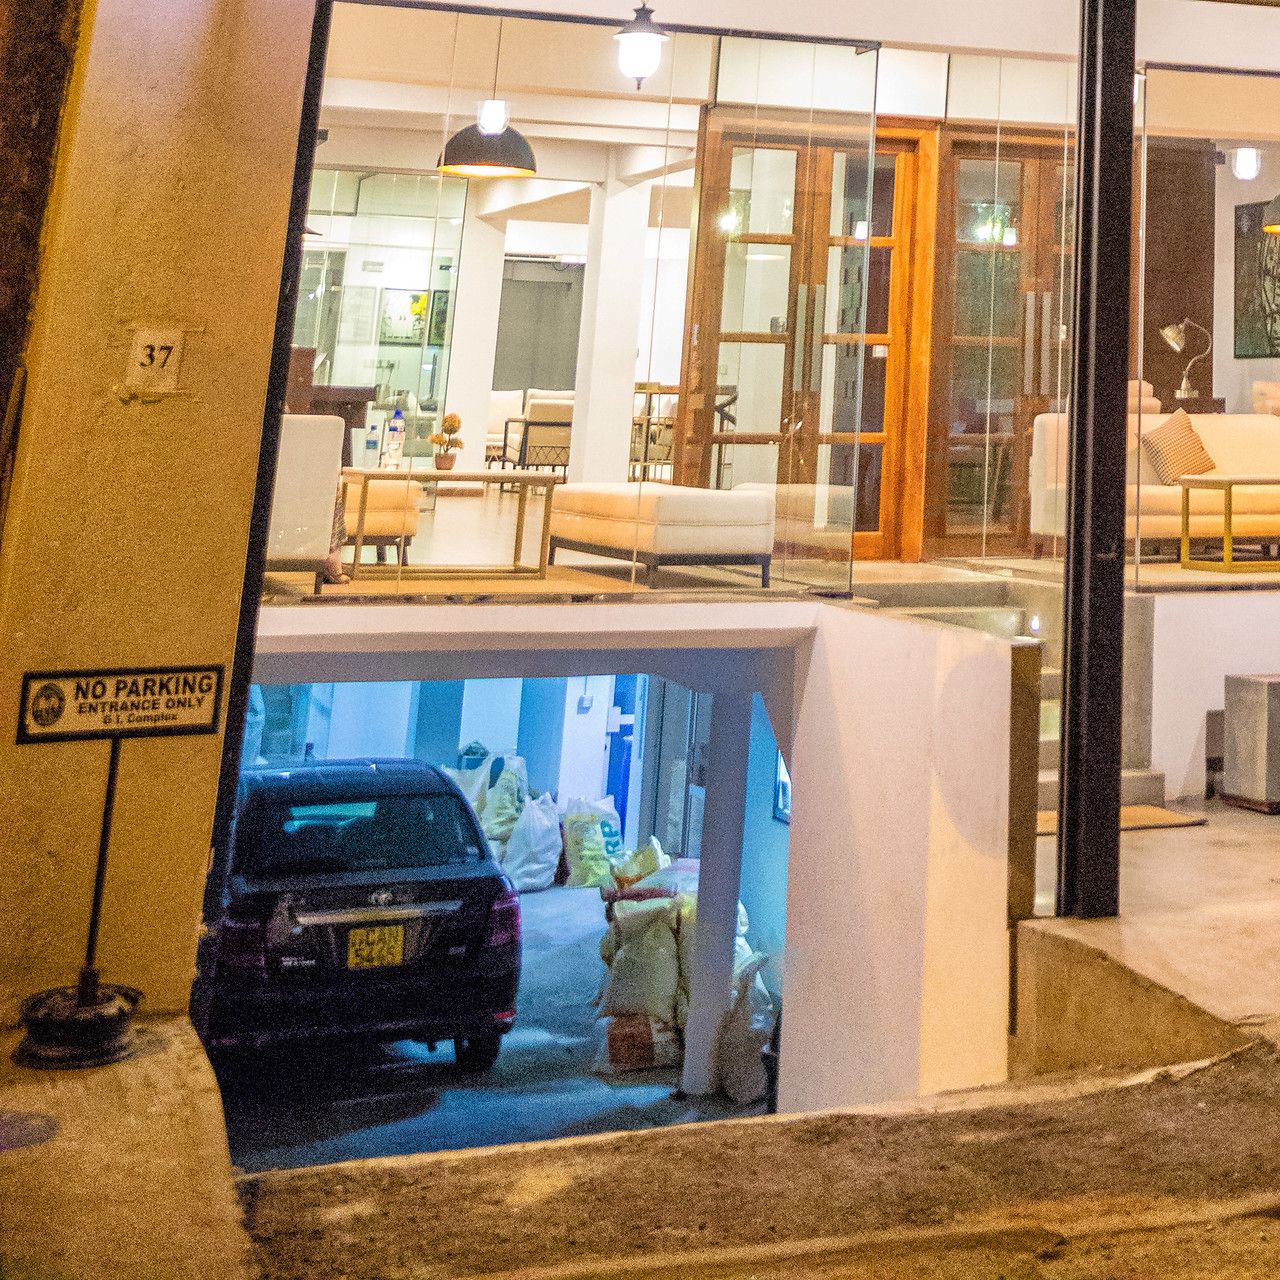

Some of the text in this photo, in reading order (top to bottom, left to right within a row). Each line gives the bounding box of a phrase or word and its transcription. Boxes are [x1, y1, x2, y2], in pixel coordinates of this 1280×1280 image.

[140, 344, 174, 369] 37
[75, 674, 213, 699] NO PARKING
[78, 695, 206, 713] ENTRANCE ONLY
